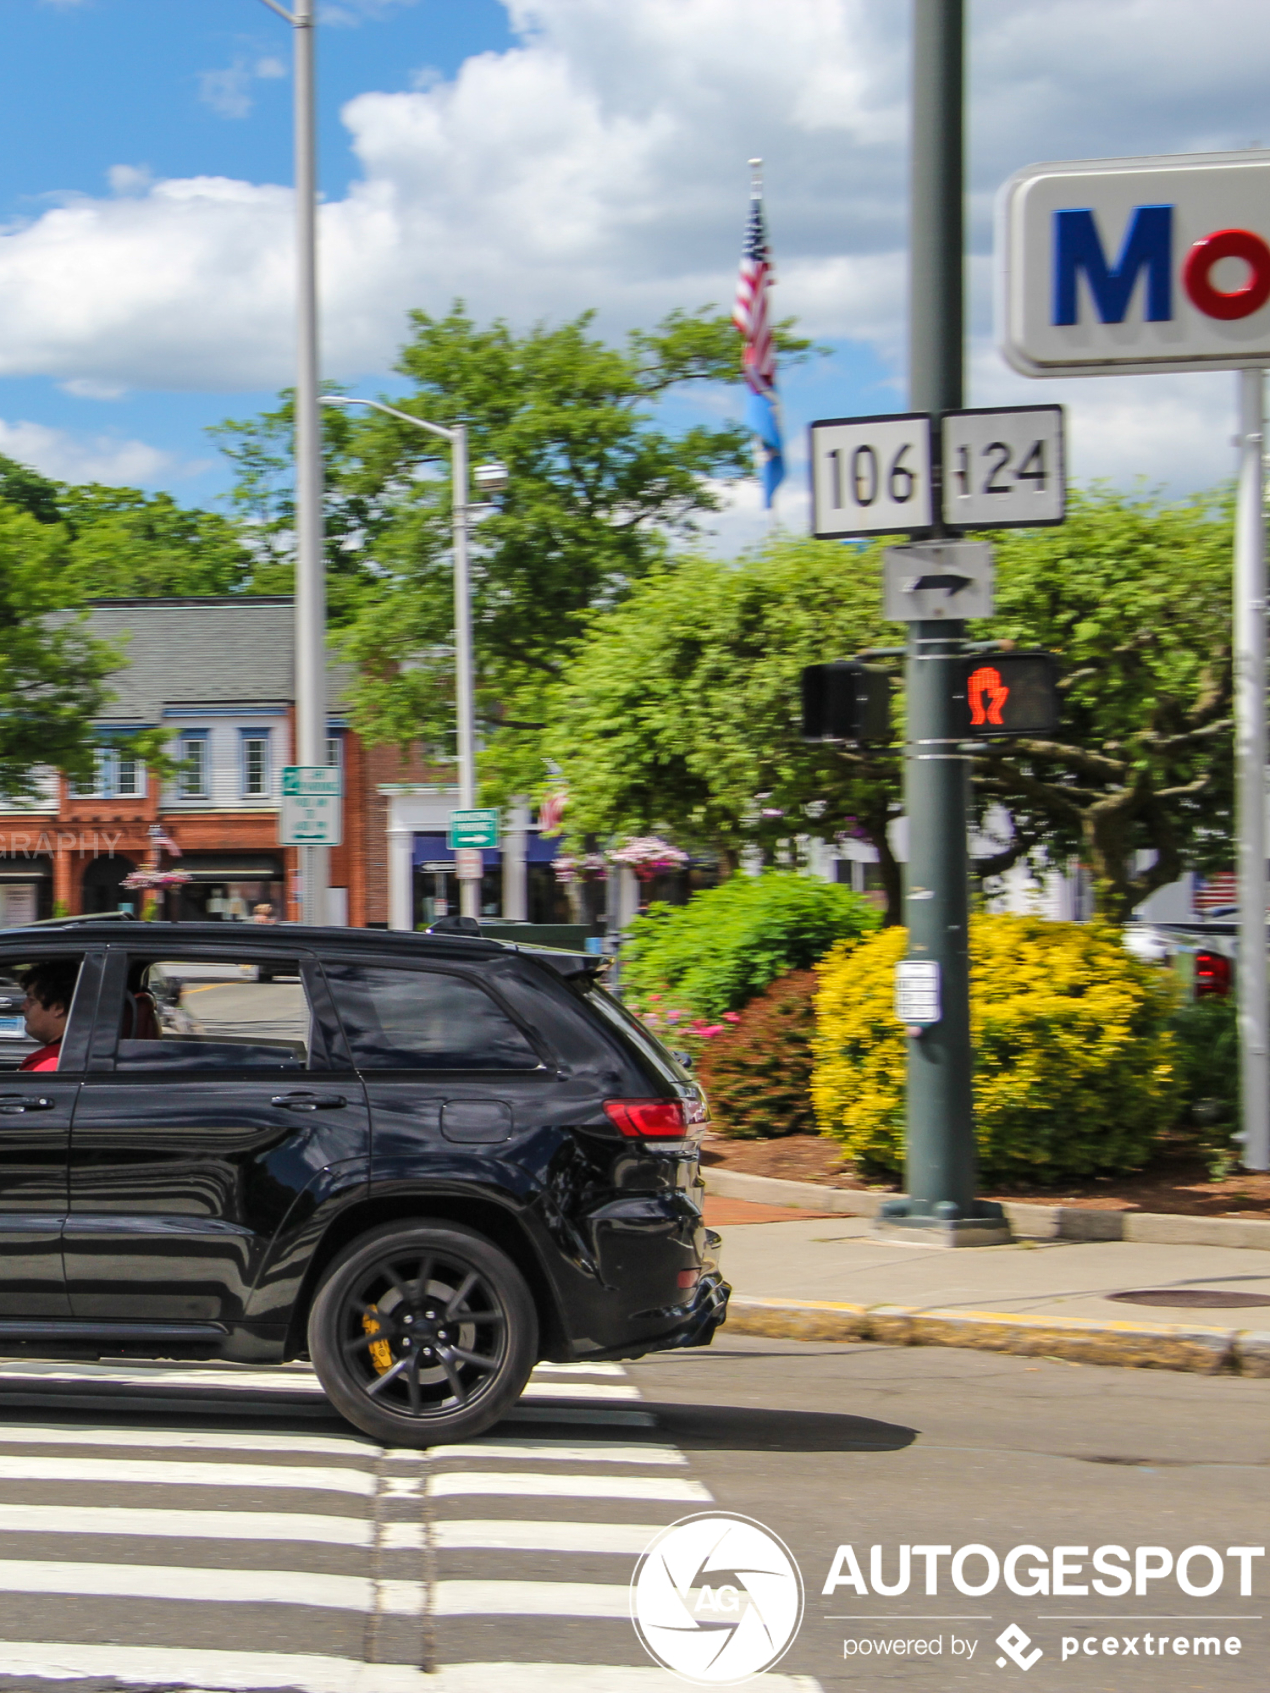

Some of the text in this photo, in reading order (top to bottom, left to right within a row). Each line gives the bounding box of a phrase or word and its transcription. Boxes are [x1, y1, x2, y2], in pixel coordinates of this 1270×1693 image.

[1050, 204, 1270, 326] Mo
[826, 443, 915, 509] 106
[956, 439, 1048, 499] 124
